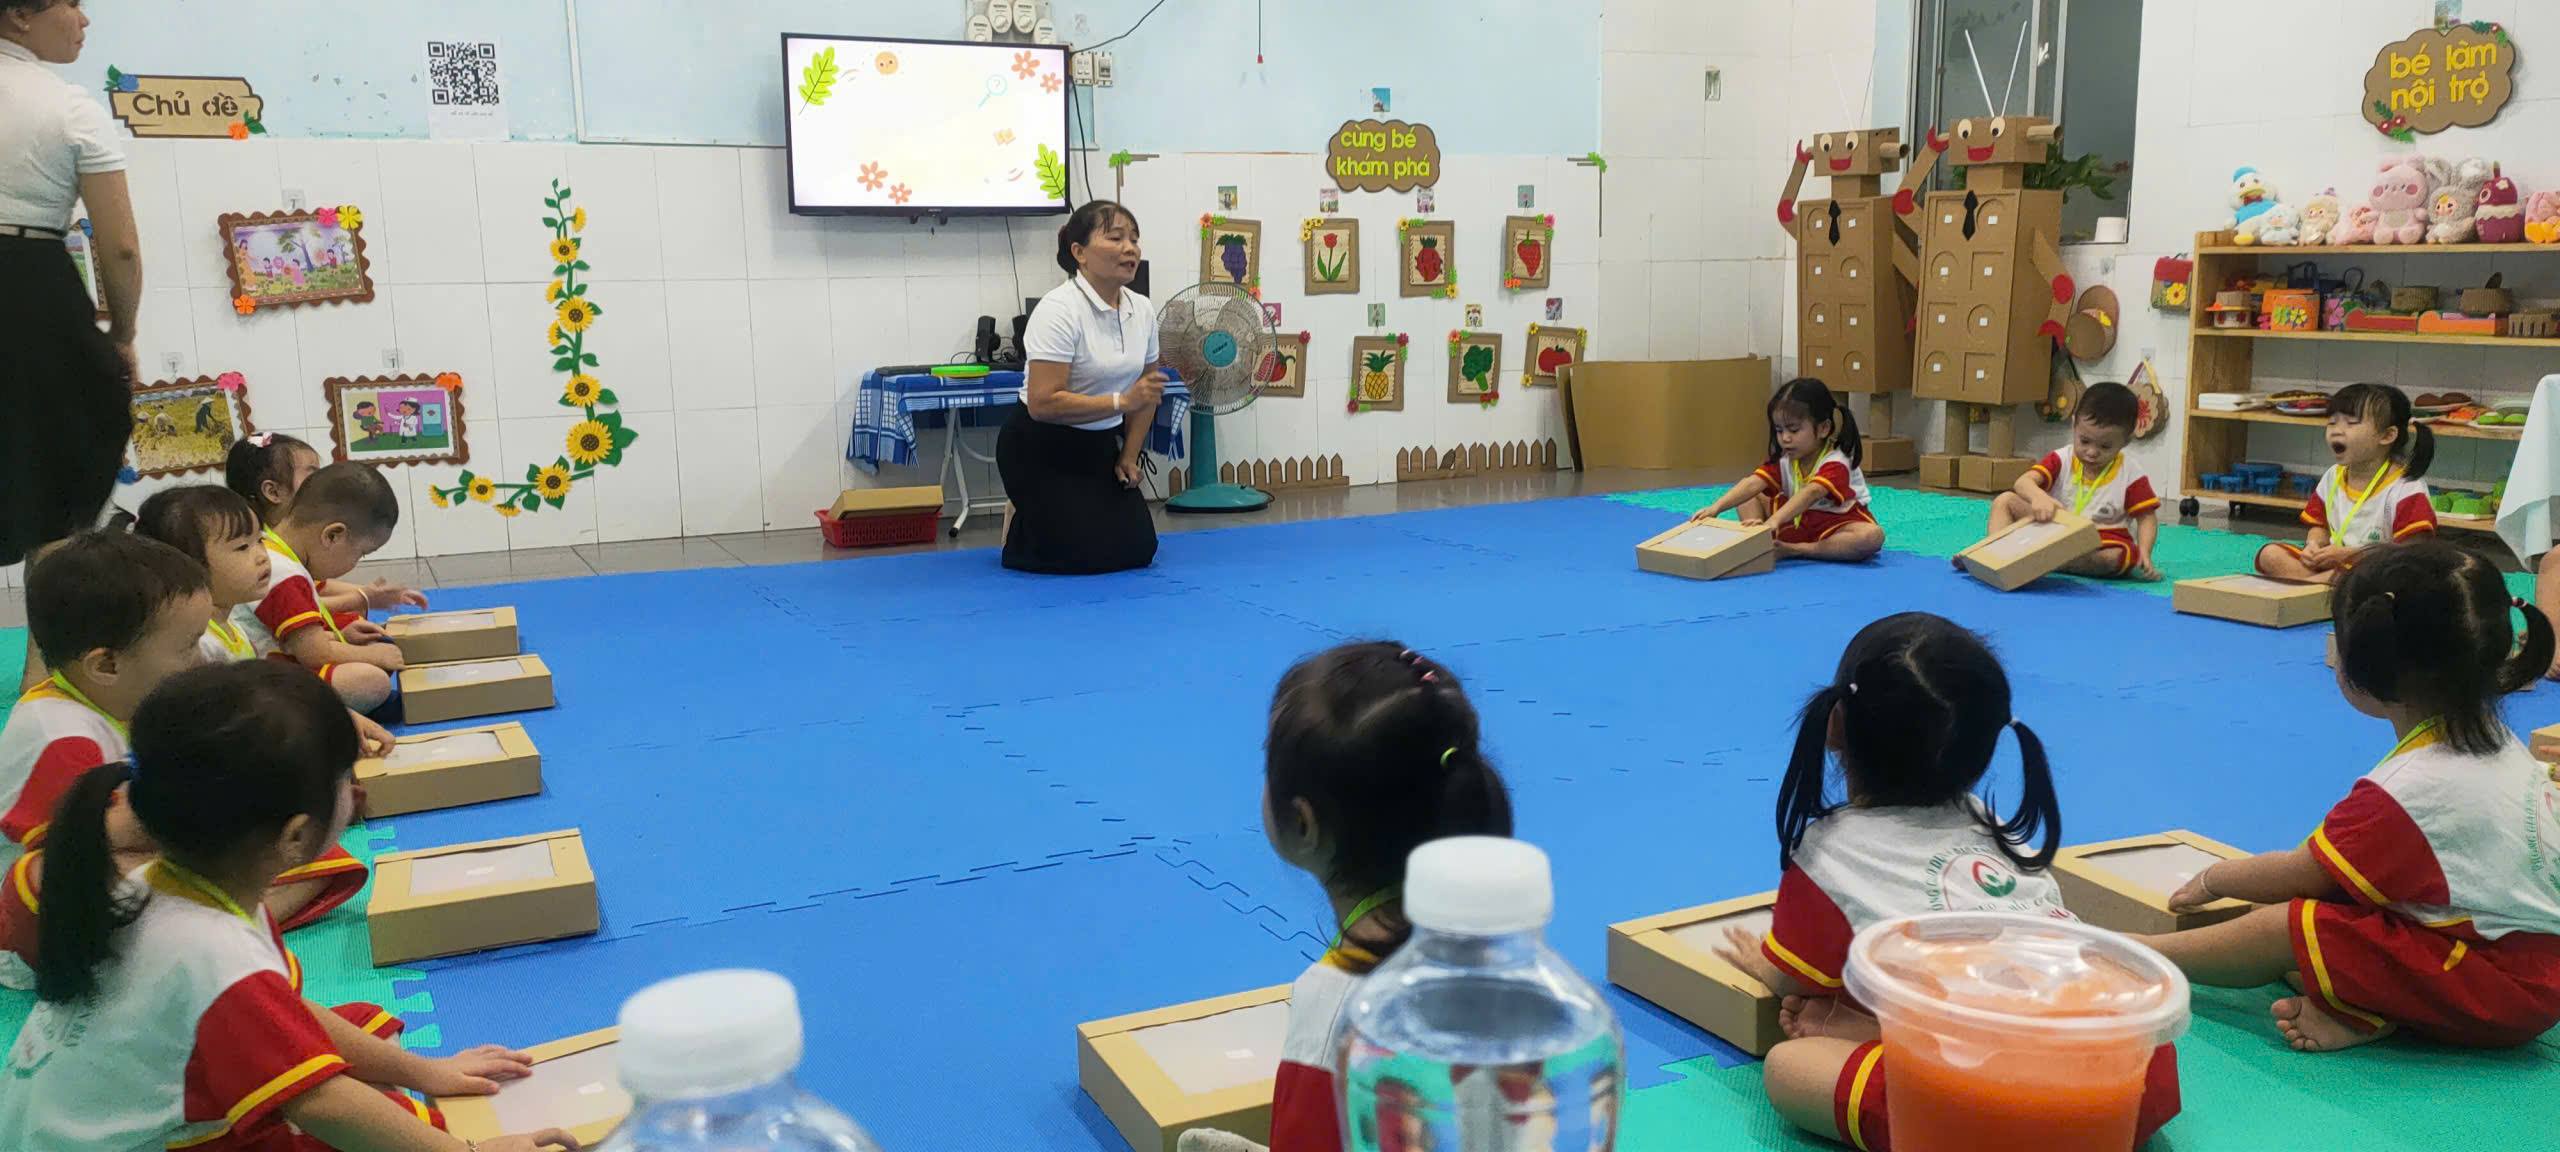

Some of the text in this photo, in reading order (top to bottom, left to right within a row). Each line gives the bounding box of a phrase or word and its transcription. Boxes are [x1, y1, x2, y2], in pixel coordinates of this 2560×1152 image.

[2390, 40, 2497, 79] bé làm
[132, 90, 239, 117] Chủ đề
[2391, 70, 2490, 114] nội trợ
[1341, 124, 1417, 152] cùng bé
[1336, 153, 1430, 181] khám phá
